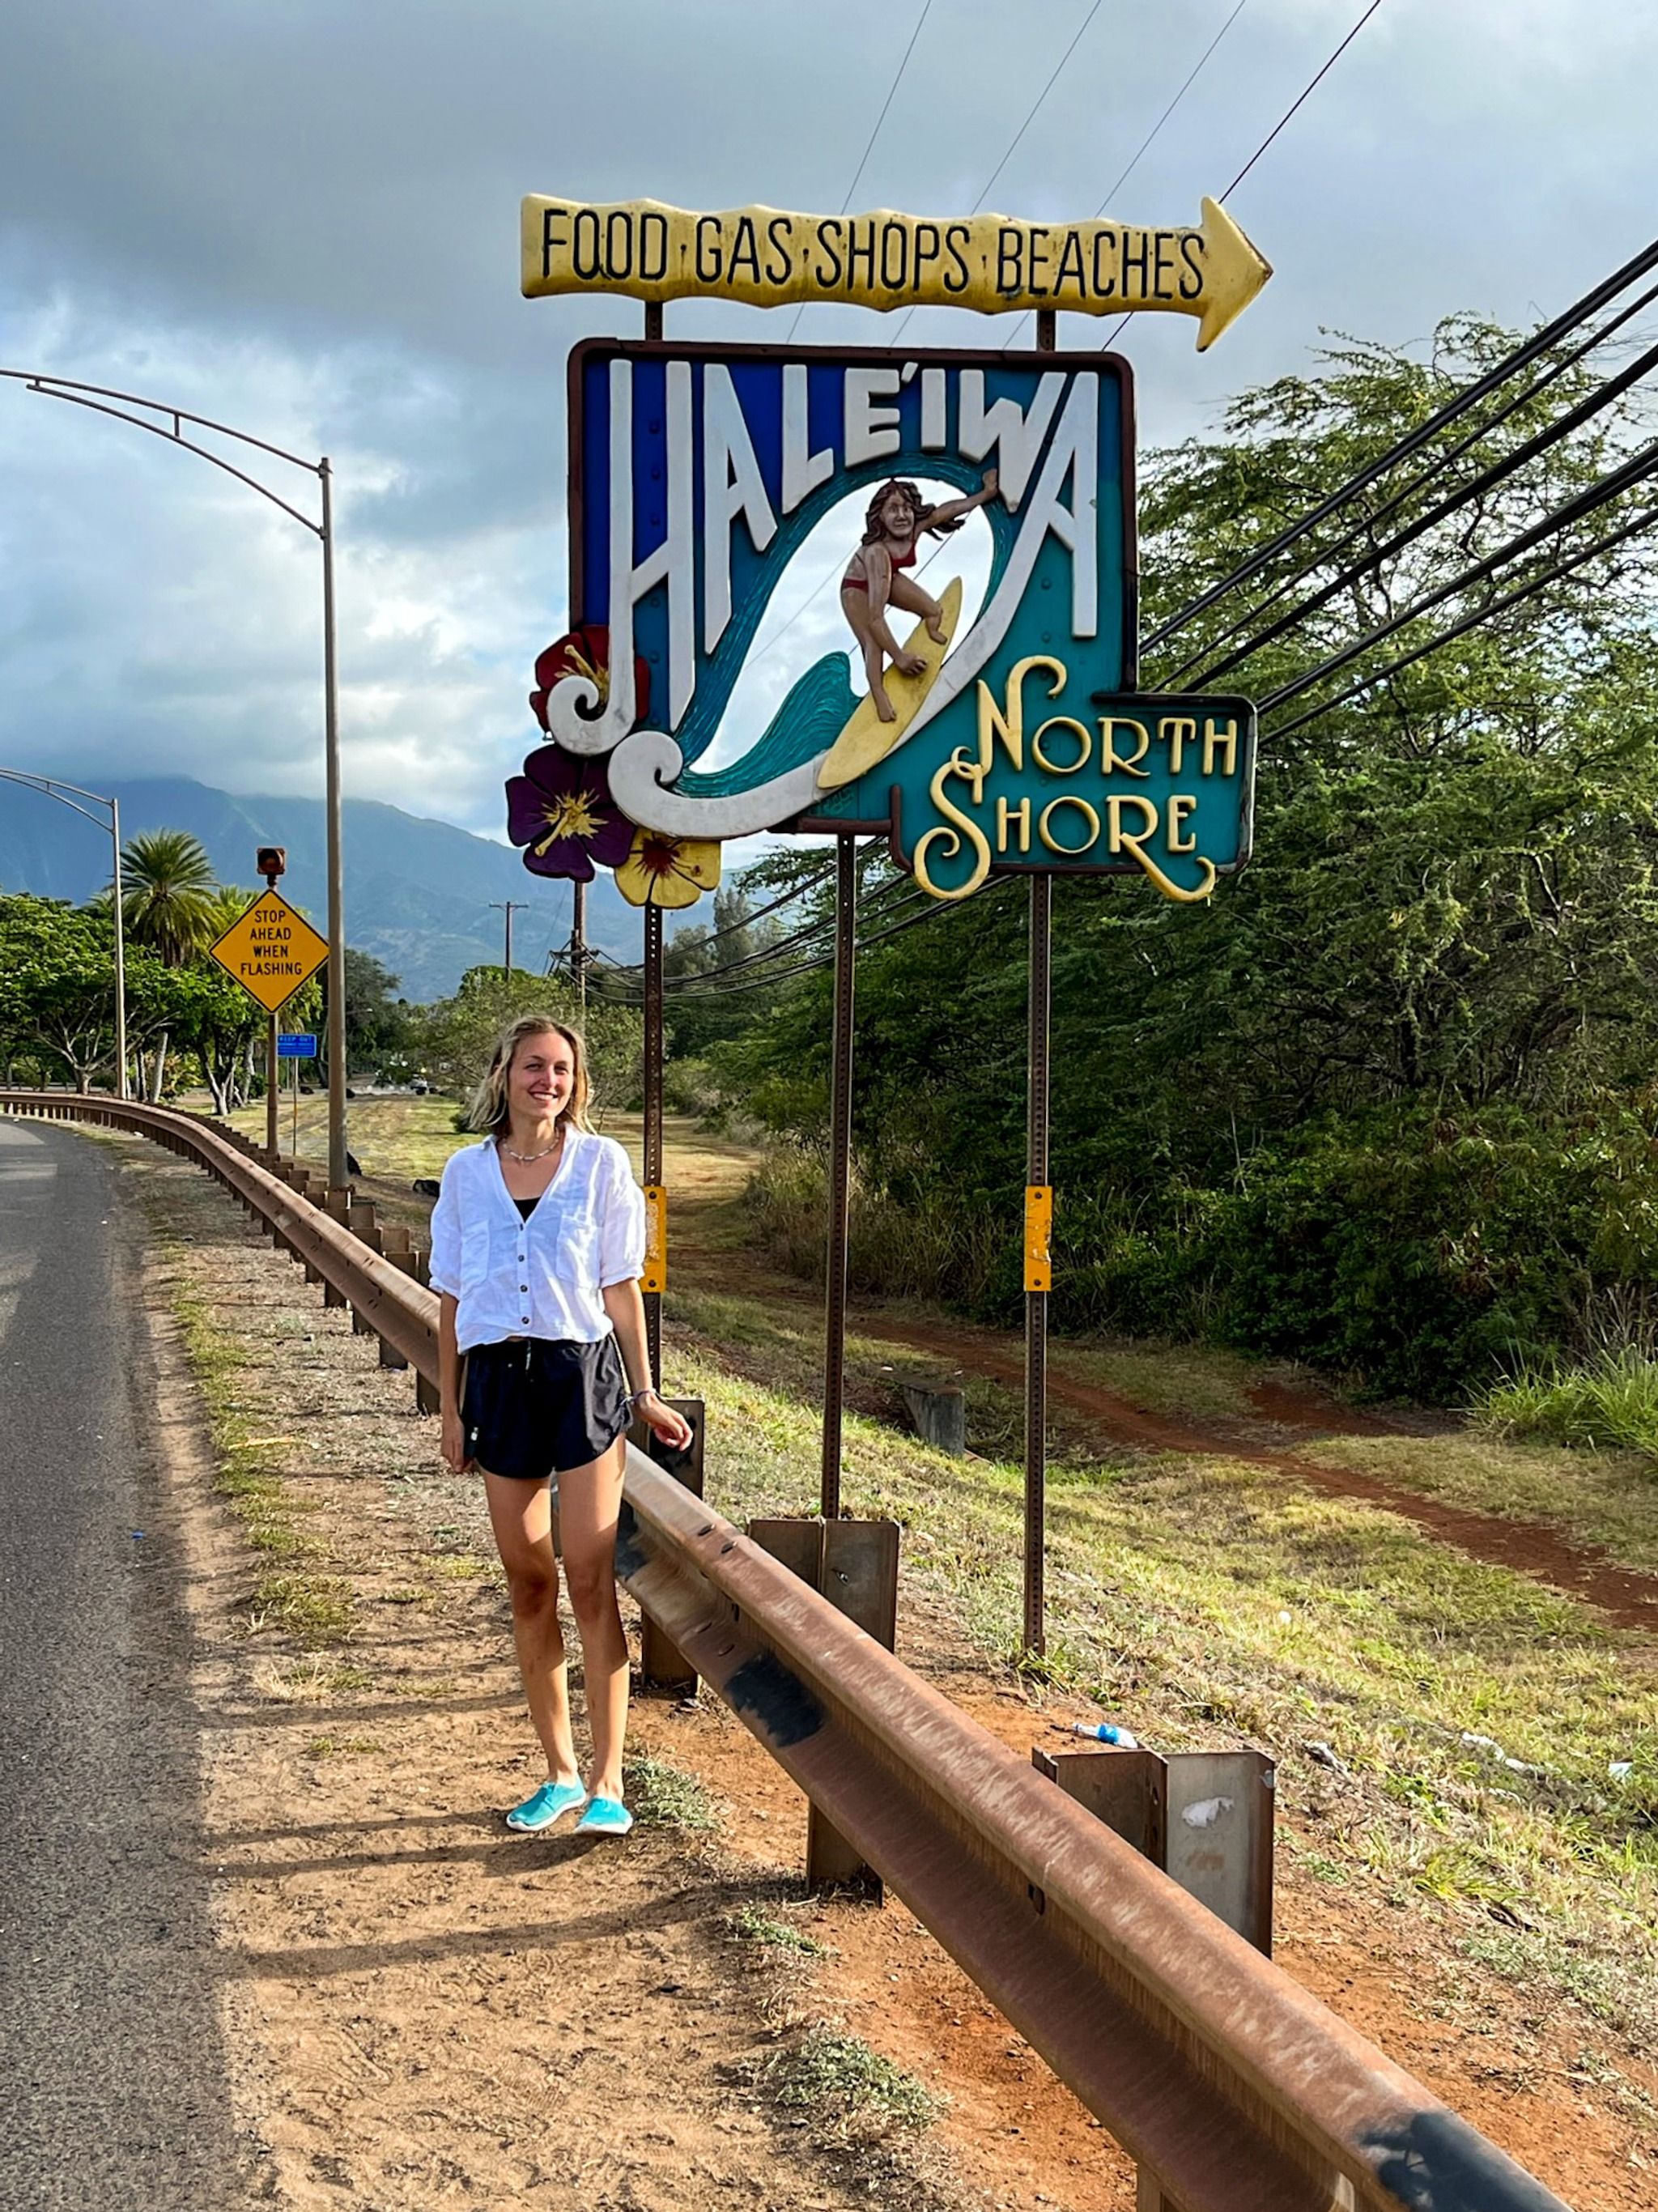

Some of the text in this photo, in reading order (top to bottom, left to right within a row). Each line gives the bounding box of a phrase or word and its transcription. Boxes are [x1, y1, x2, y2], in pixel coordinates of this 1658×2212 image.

[542, 209, 1205, 300] FOOD GAS SHOPS BEACHES
[976, 655, 1238, 779] NORTH
[912, 746, 1217, 902] SHORE
[254, 909, 286, 923] STOP
[249, 927, 291, 941] AHEAD
[253, 945, 289, 958] WHEN
[240, 962, 302, 976] FLASHING
